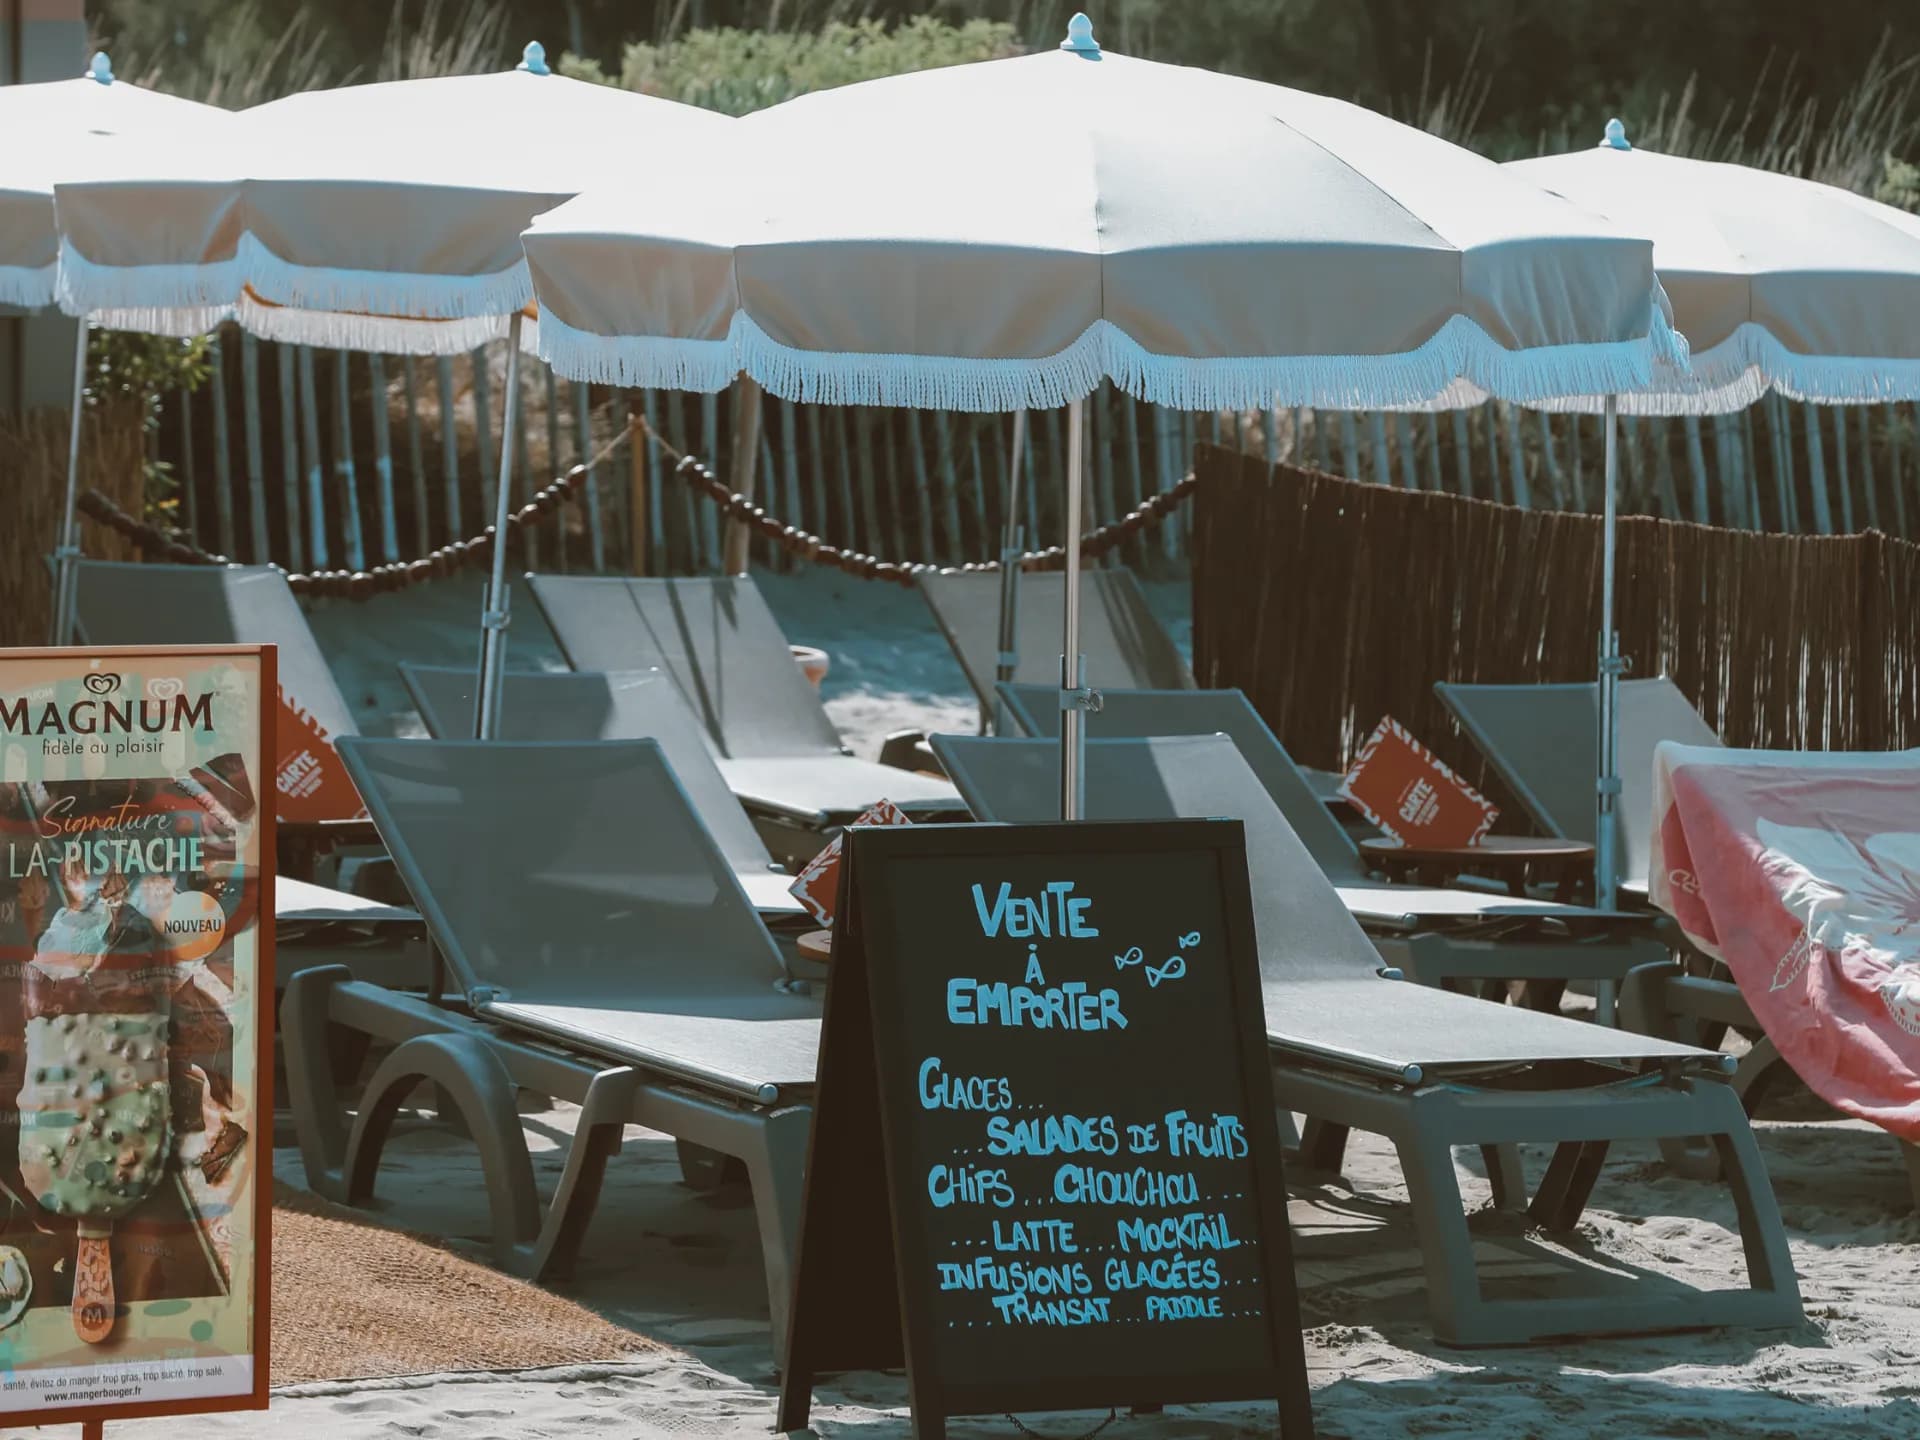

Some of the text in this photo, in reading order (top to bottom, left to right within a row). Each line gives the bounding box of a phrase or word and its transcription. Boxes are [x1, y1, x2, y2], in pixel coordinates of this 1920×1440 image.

[0, 691, 215, 736] MAGNUM
[42, 738, 165, 758] fidèle au plaisir
[277, 750, 318, 793] CARTE
[40, 795, 172, 841] Signature
[1399, 777, 1434, 822] CARTE
[164, 919, 222, 934] NOUVEAU
[971, 881, 1099, 938] VENTE
[946, 977, 1129, 1031] EMPORTER
[1126, 1123, 1160, 1154] DE
[44, 1386, 142, 1402] www.mangerbouger.fr
[69, 1375, 101, 1387] manger
[102, 1373, 119, 1384] trop
[121, 1373, 141, 1384] gras,
[143, 1371, 159, 1381] trop
[187, 1367, 203, 1378] trop
